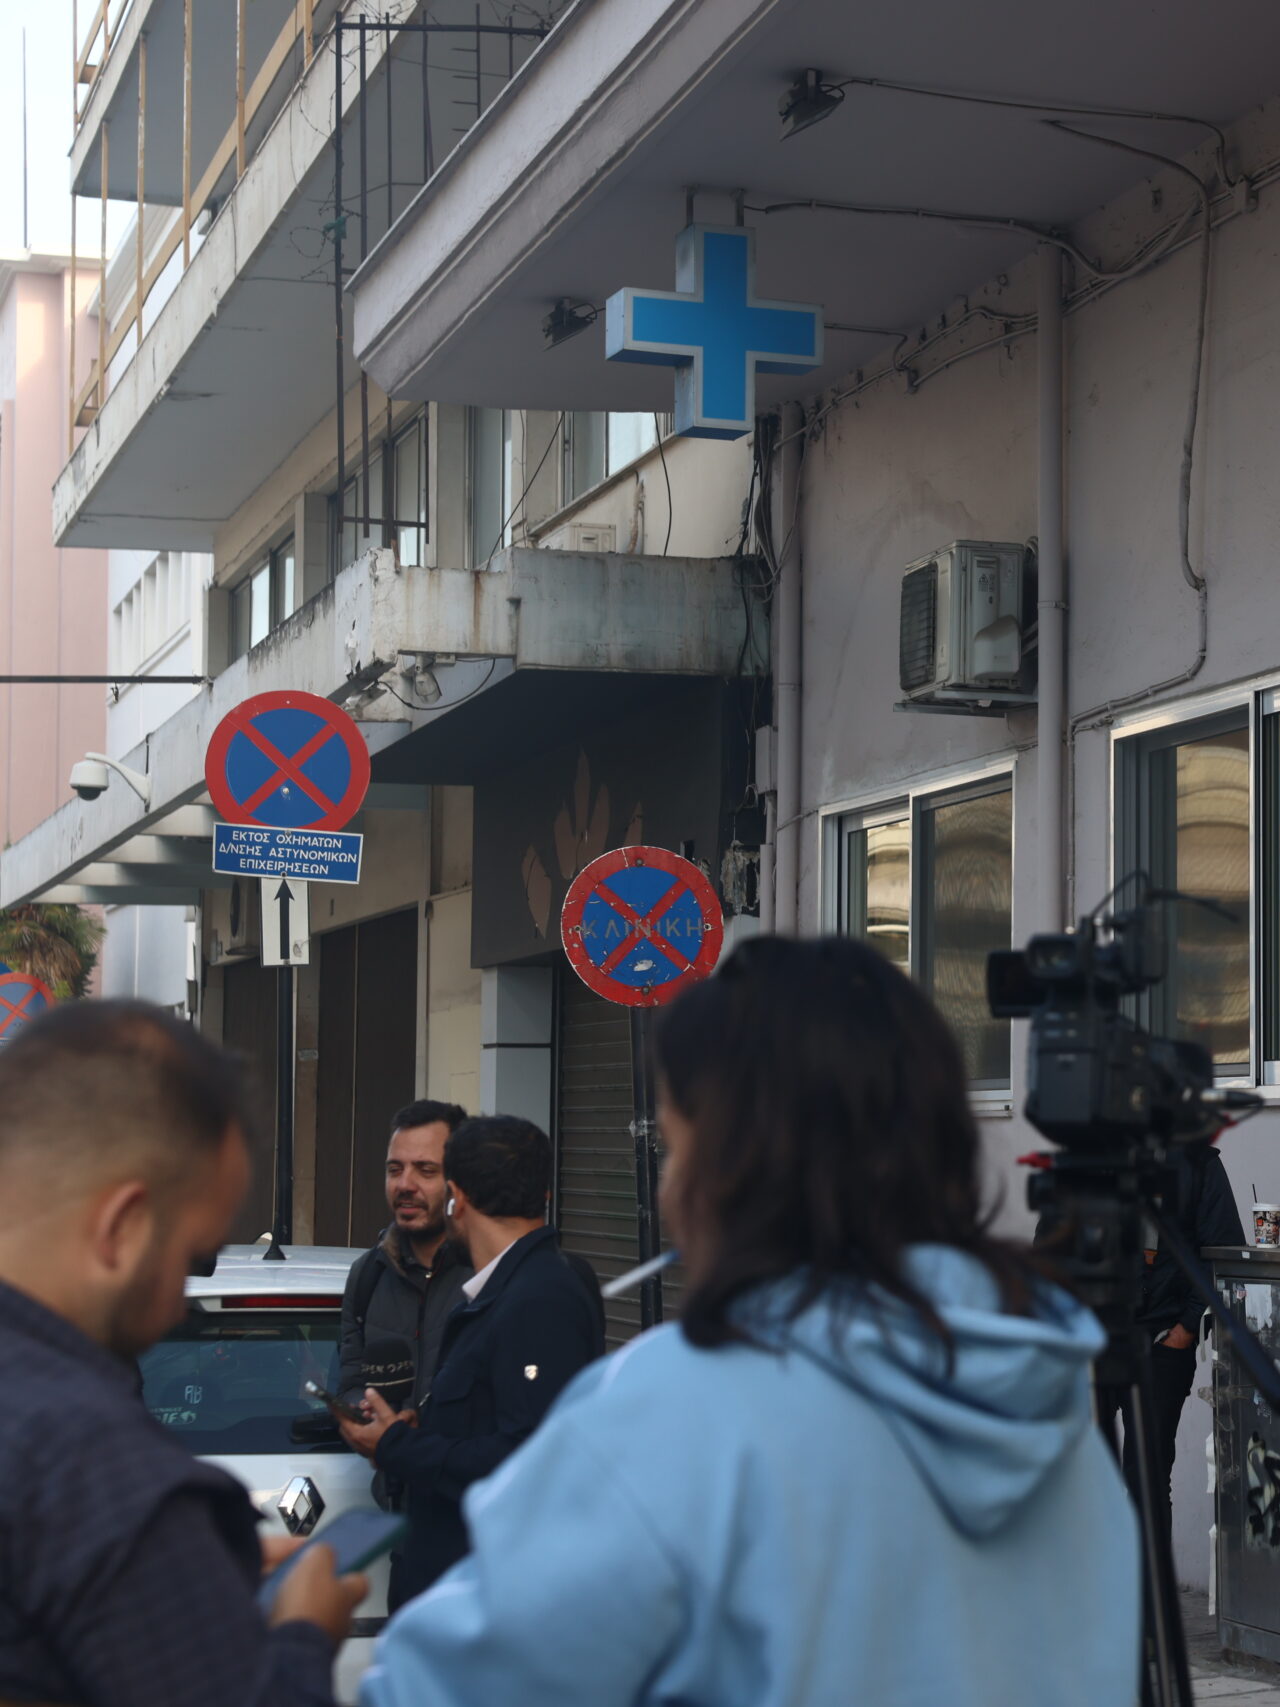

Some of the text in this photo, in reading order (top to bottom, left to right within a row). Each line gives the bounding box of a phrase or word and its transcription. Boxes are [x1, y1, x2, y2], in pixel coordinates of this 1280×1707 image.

[232, 830, 342, 849] ΕΚΤΟΣ ΟΧΗΜΑΤΩΝ
[219, 842, 357, 864] Δ/ΝΣΗΣ ΑΣΤΥΝΟΜΙΚΩΝ
[240, 858, 329, 875] ΕΠΙΧΕΙΡΗΣΕΩΝ
[581, 917, 703, 939] ΚΛΙΝΙΚΗ
